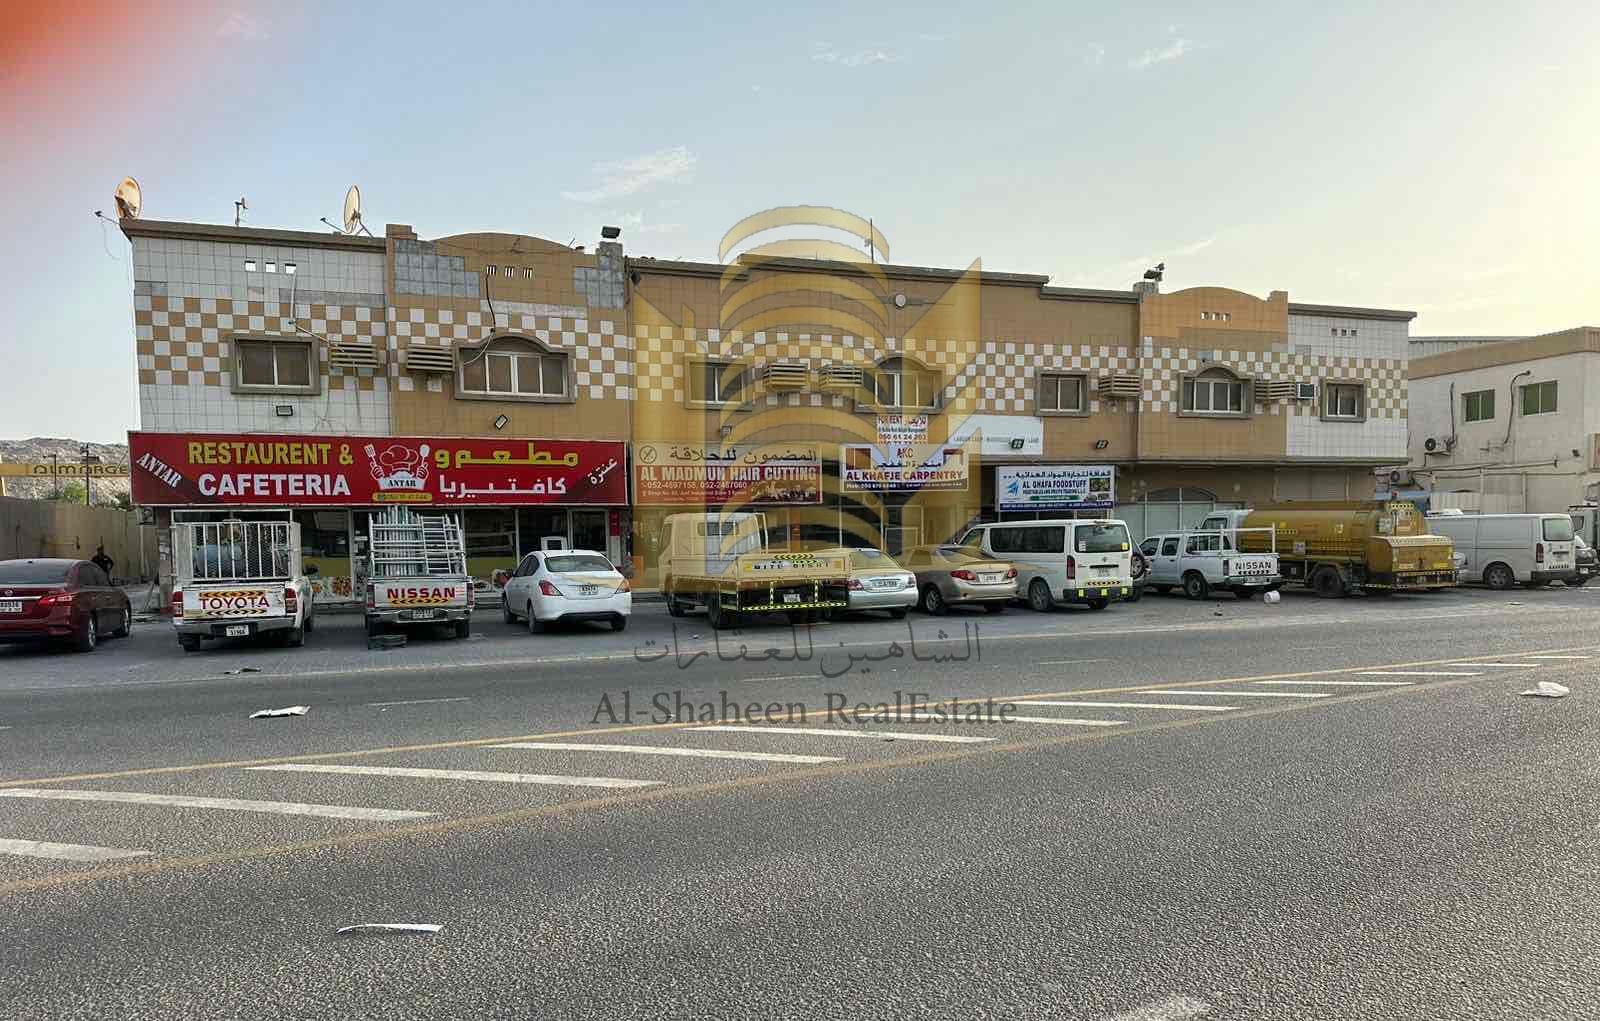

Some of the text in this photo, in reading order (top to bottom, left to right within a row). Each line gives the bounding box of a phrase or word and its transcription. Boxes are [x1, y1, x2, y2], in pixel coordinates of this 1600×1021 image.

[188, 442, 354, 465] RESTAURENT &
[455, 442, 579, 468] مطعم
[136, 452, 184, 488] ANTAR
[641, 466, 658, 481] AL
[729, 466, 761, 481] HAIR
[764, 465, 817, 481] CUTTING
[846, 471, 860, 480] AL
[902, 470, 962, 480] CARPENTRY
[198, 473, 352, 496] CAFETERIA
[388, 479, 417, 487] ANTAR
[439, 475, 567, 498] كافتيريا
[1022, 480, 1030, 489] AL
[1053, 480, 1087, 489] FOODSTUFF
[1235, 561, 1271, 570] NISSAN
[387, 587, 456, 599] NISSAN
[199, 597, 270, 610] TOYOTA
